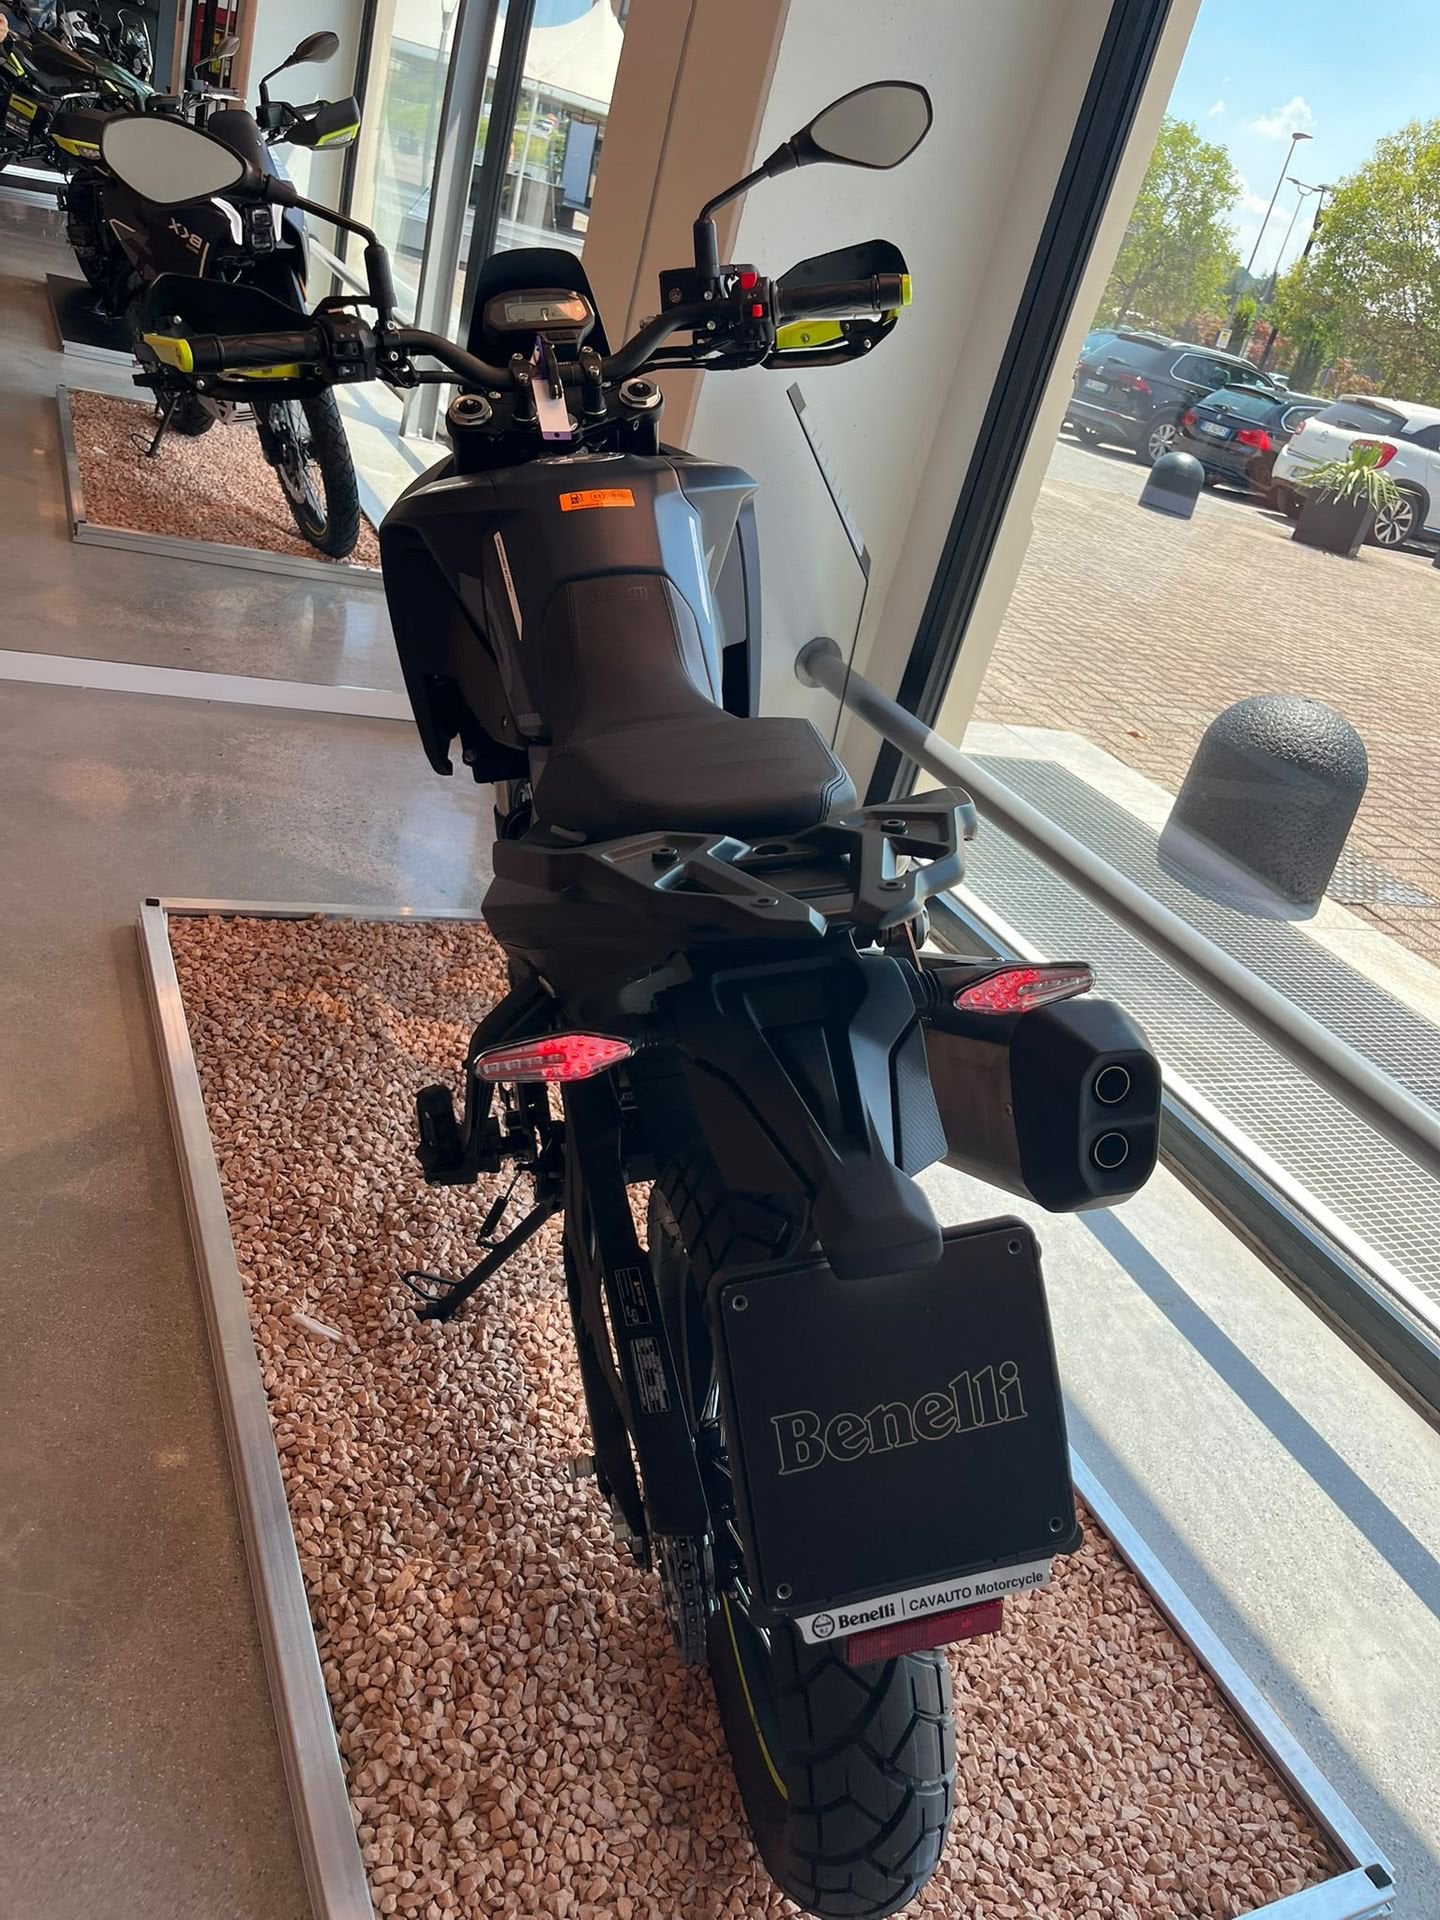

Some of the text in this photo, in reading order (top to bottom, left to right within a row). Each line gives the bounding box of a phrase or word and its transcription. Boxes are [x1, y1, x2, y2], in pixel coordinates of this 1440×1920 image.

[770, 1361, 1028, 1475] Benelli
[838, 1603, 896, 1629] Benelli
[909, 1587, 972, 1611] CAVAUTO
[975, 1571, 1043, 1596] Motorcycle
